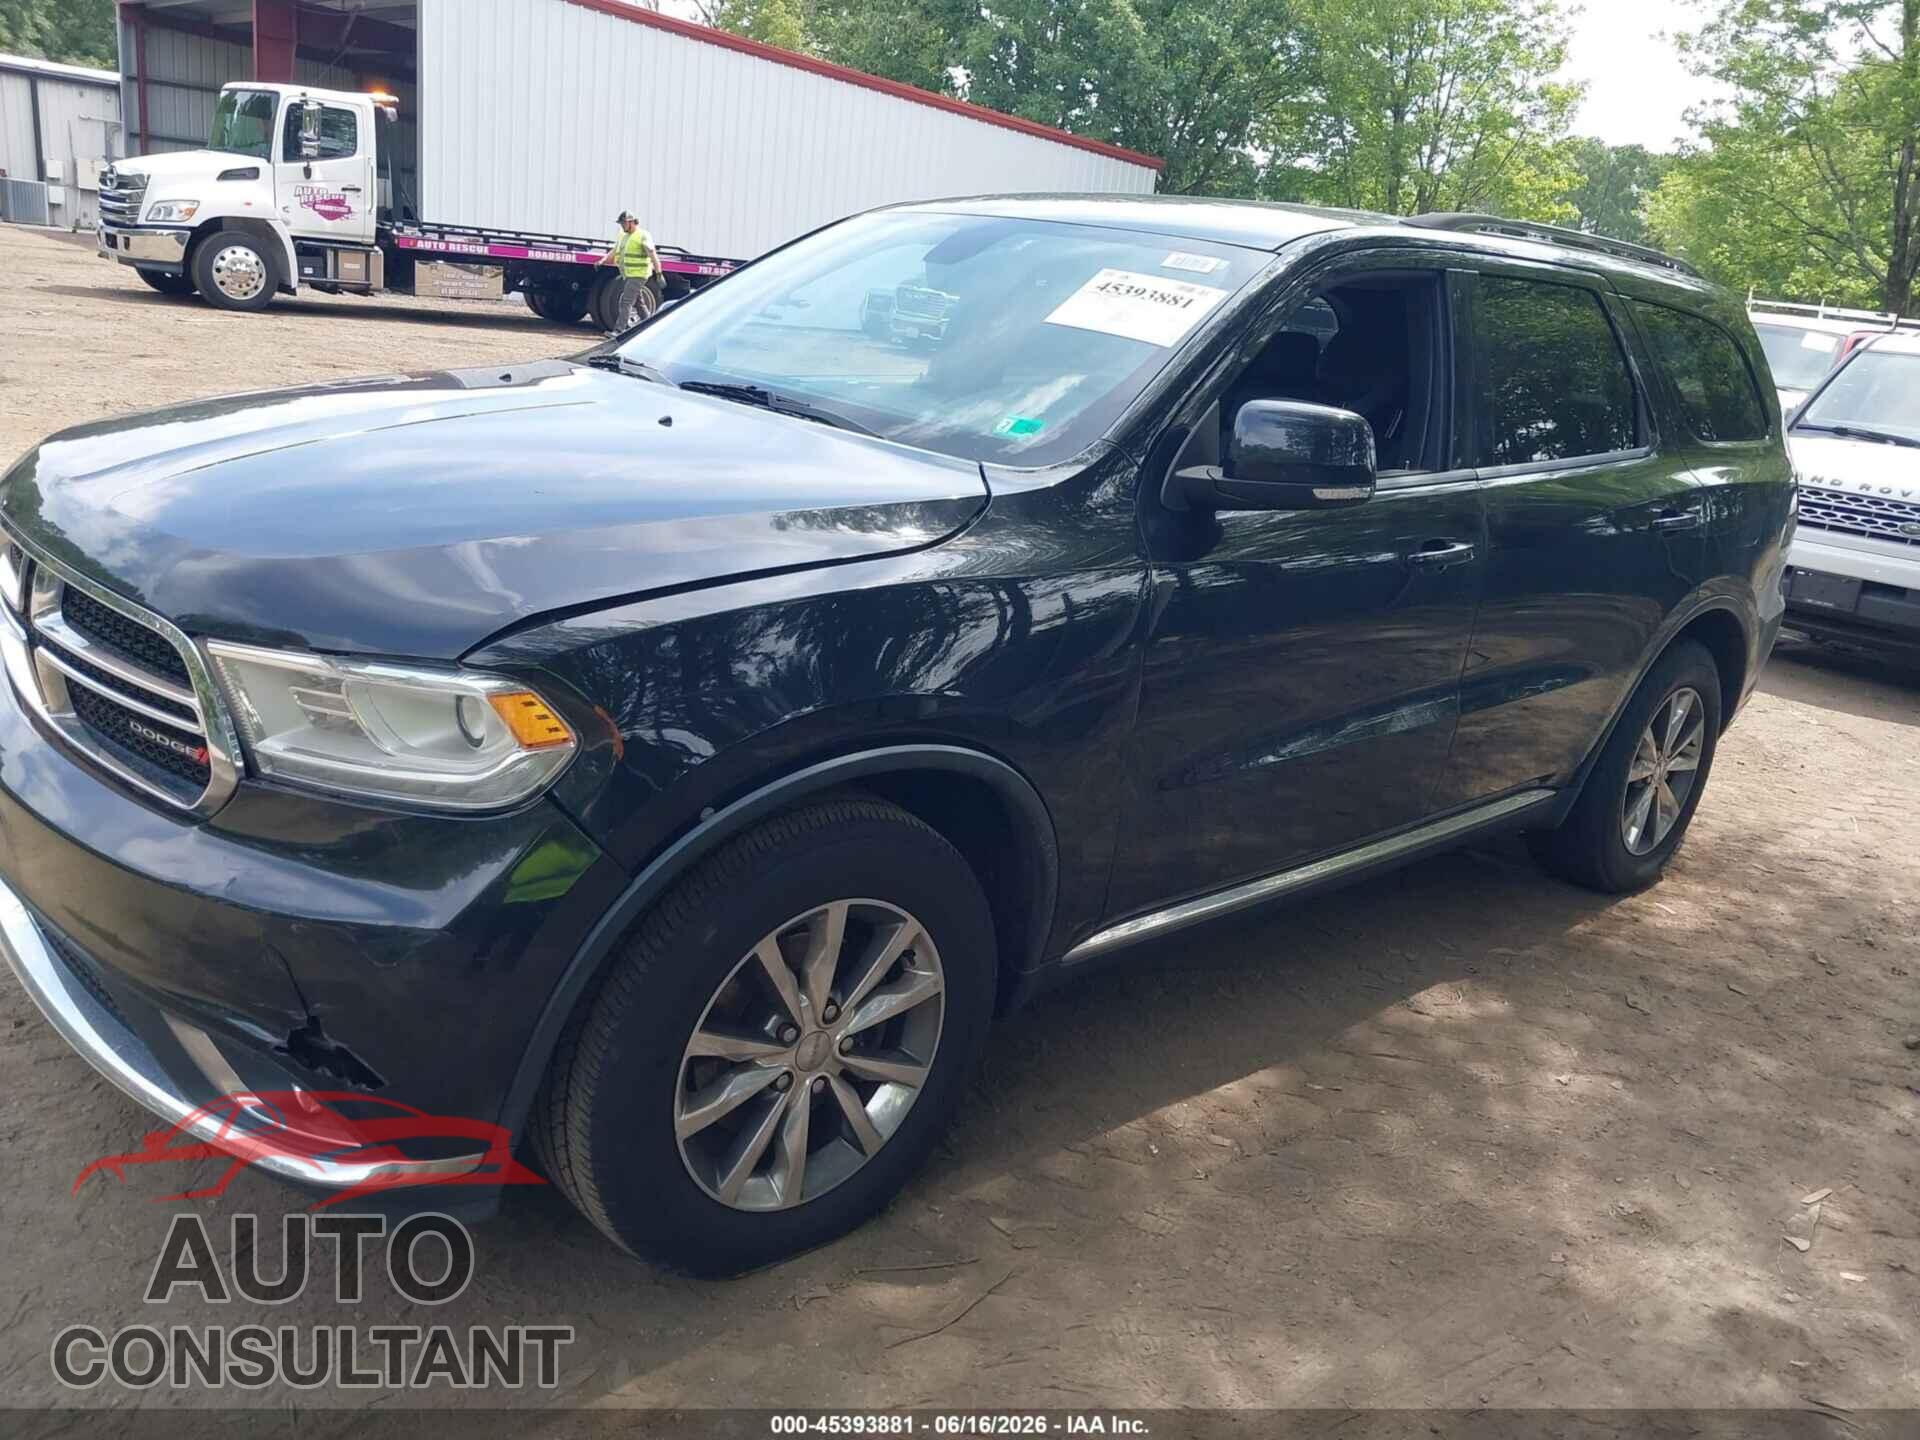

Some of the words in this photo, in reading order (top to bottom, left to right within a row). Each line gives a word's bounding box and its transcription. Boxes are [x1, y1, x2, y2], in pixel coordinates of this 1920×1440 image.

[295, 185, 328, 197] AUTO
[416, 238, 447, 251] AUTO
[448, 240, 490, 255] RESCUE
[528, 250, 577, 263] ROADSIDE
[1096, 281, 1194, 309] 45393881
[129, 720, 194, 756] DODGE
